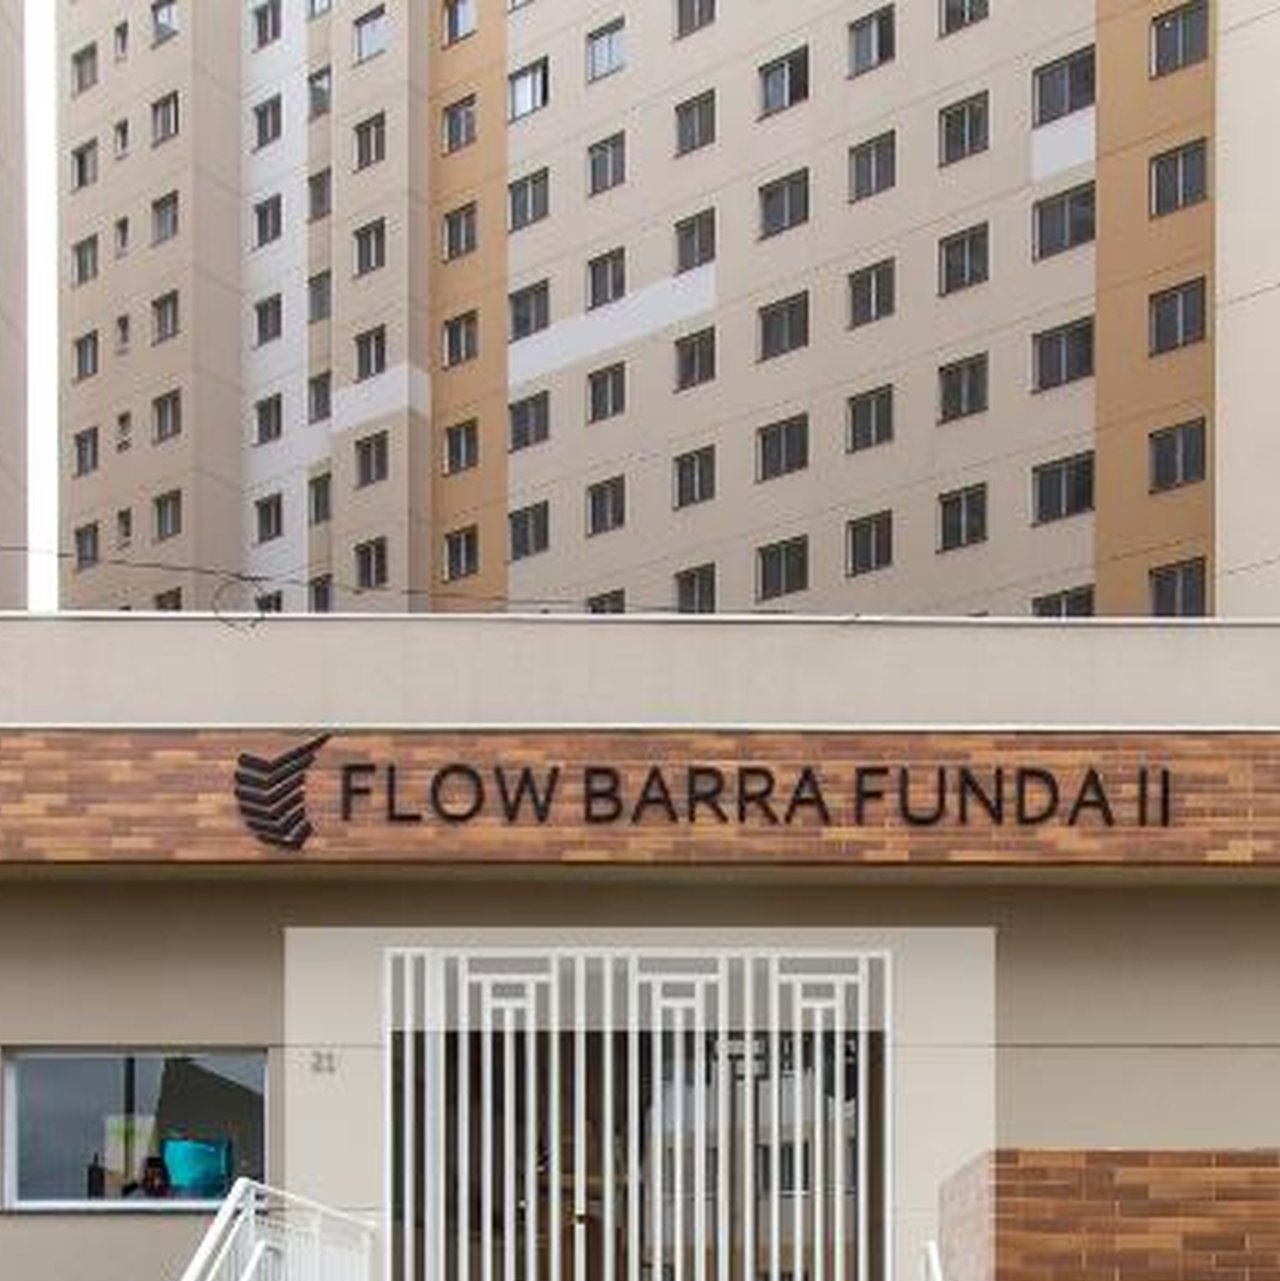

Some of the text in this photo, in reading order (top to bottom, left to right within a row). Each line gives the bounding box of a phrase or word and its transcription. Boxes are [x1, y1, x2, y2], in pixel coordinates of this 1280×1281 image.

[340, 763, 1171, 827] FLOW BARRA FUNDA II
